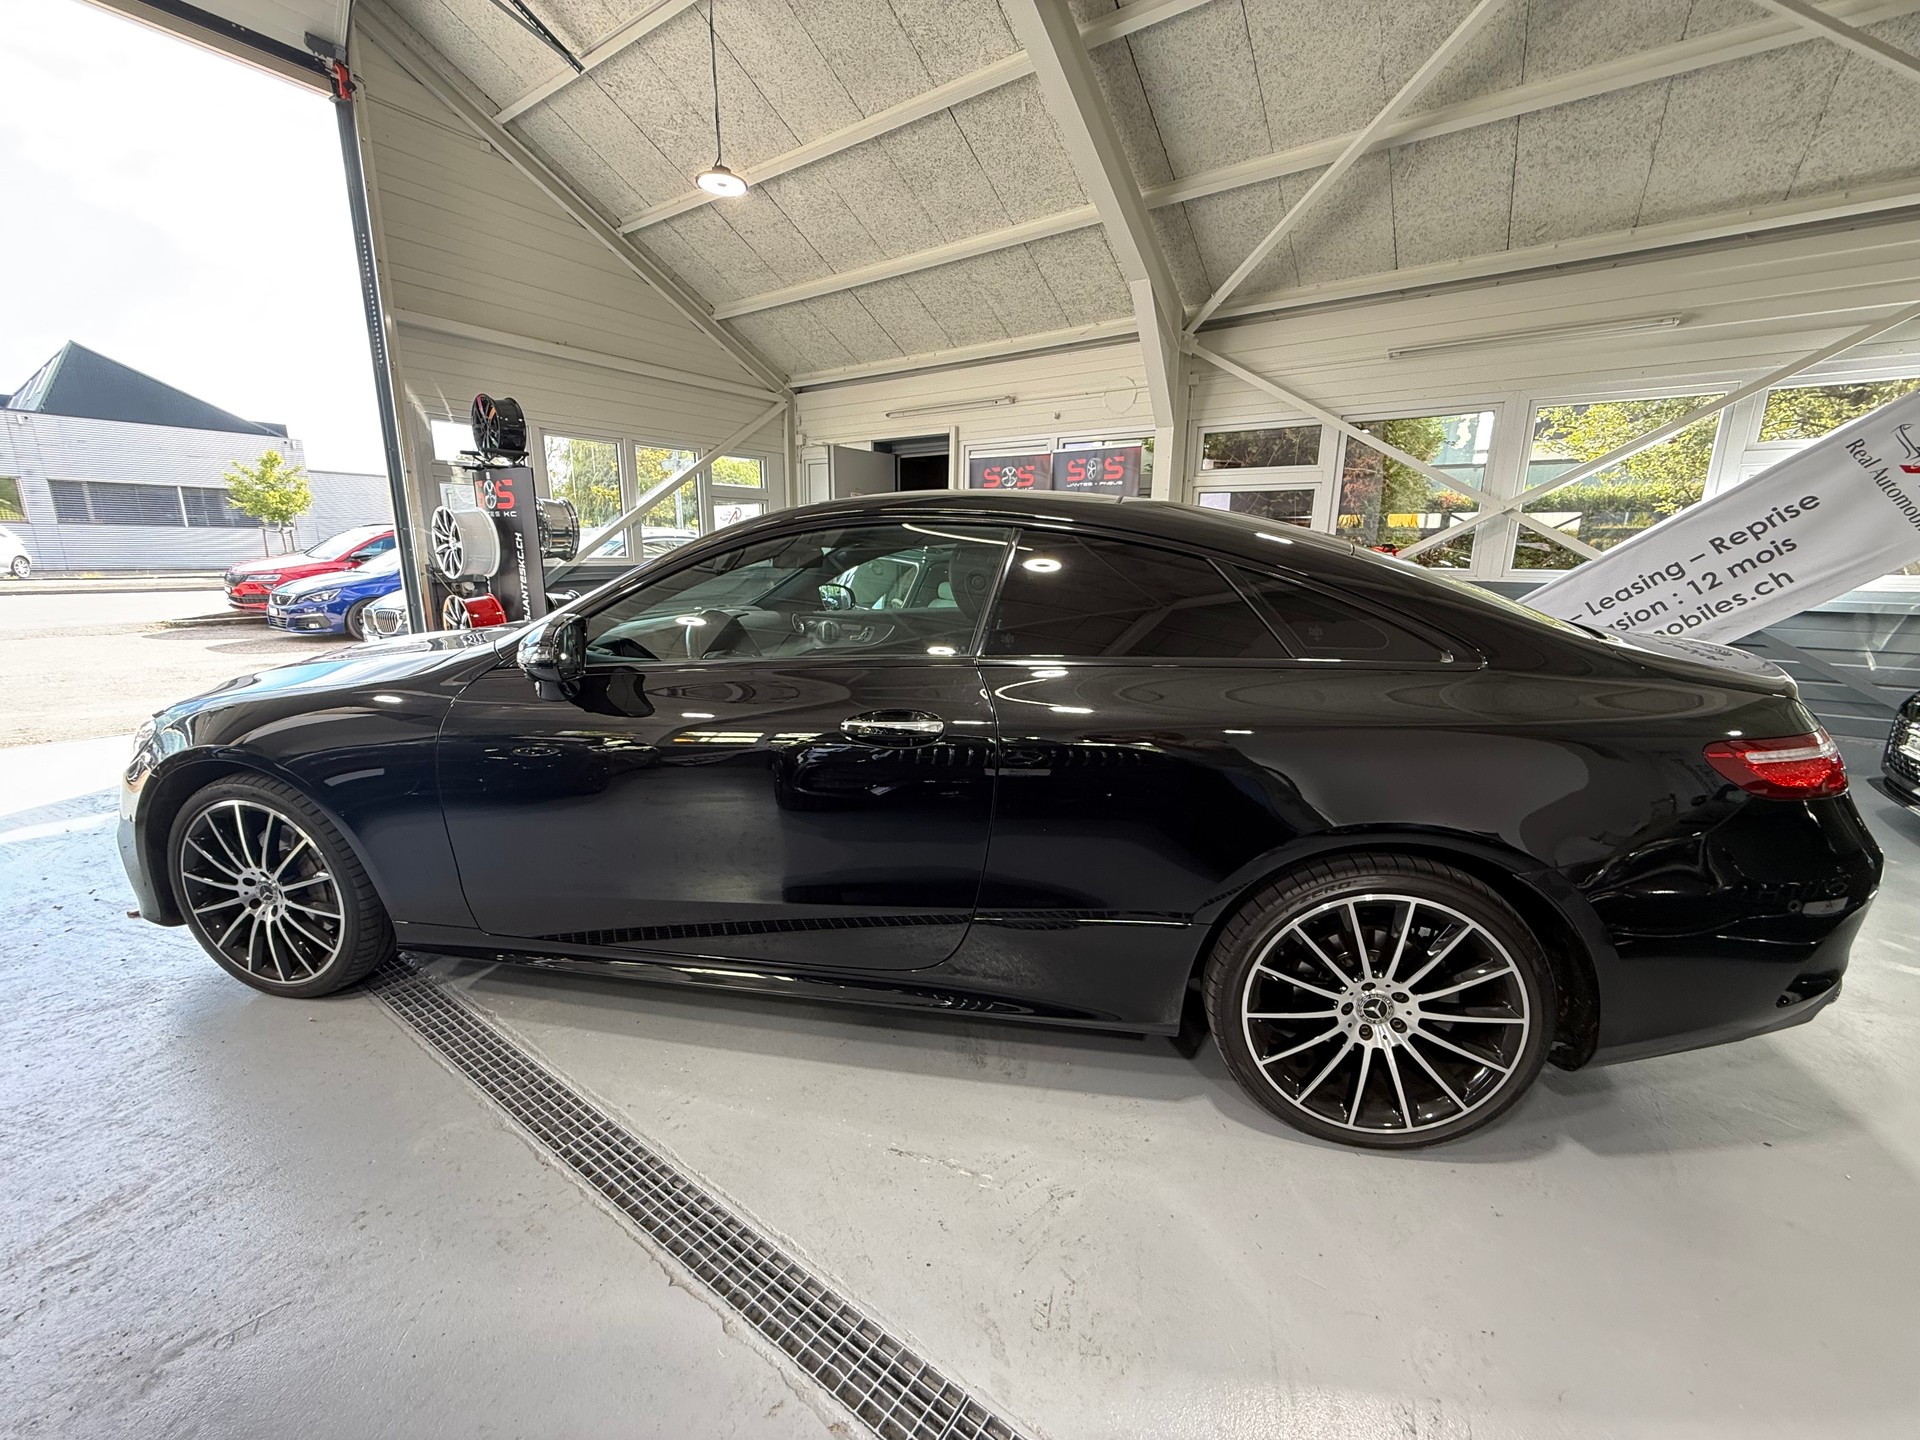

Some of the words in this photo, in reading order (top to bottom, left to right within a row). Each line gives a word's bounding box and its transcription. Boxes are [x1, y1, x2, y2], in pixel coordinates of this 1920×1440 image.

[1845, 438, 1882, 469] Real
[1585, 561, 1686, 616] Leasing
[1708, 495, 1820, 555] Reprise
[1607, 600, 1669, 631] sion
[1686, 572, 1723, 595] 12
[1727, 538, 1797, 578] mois
